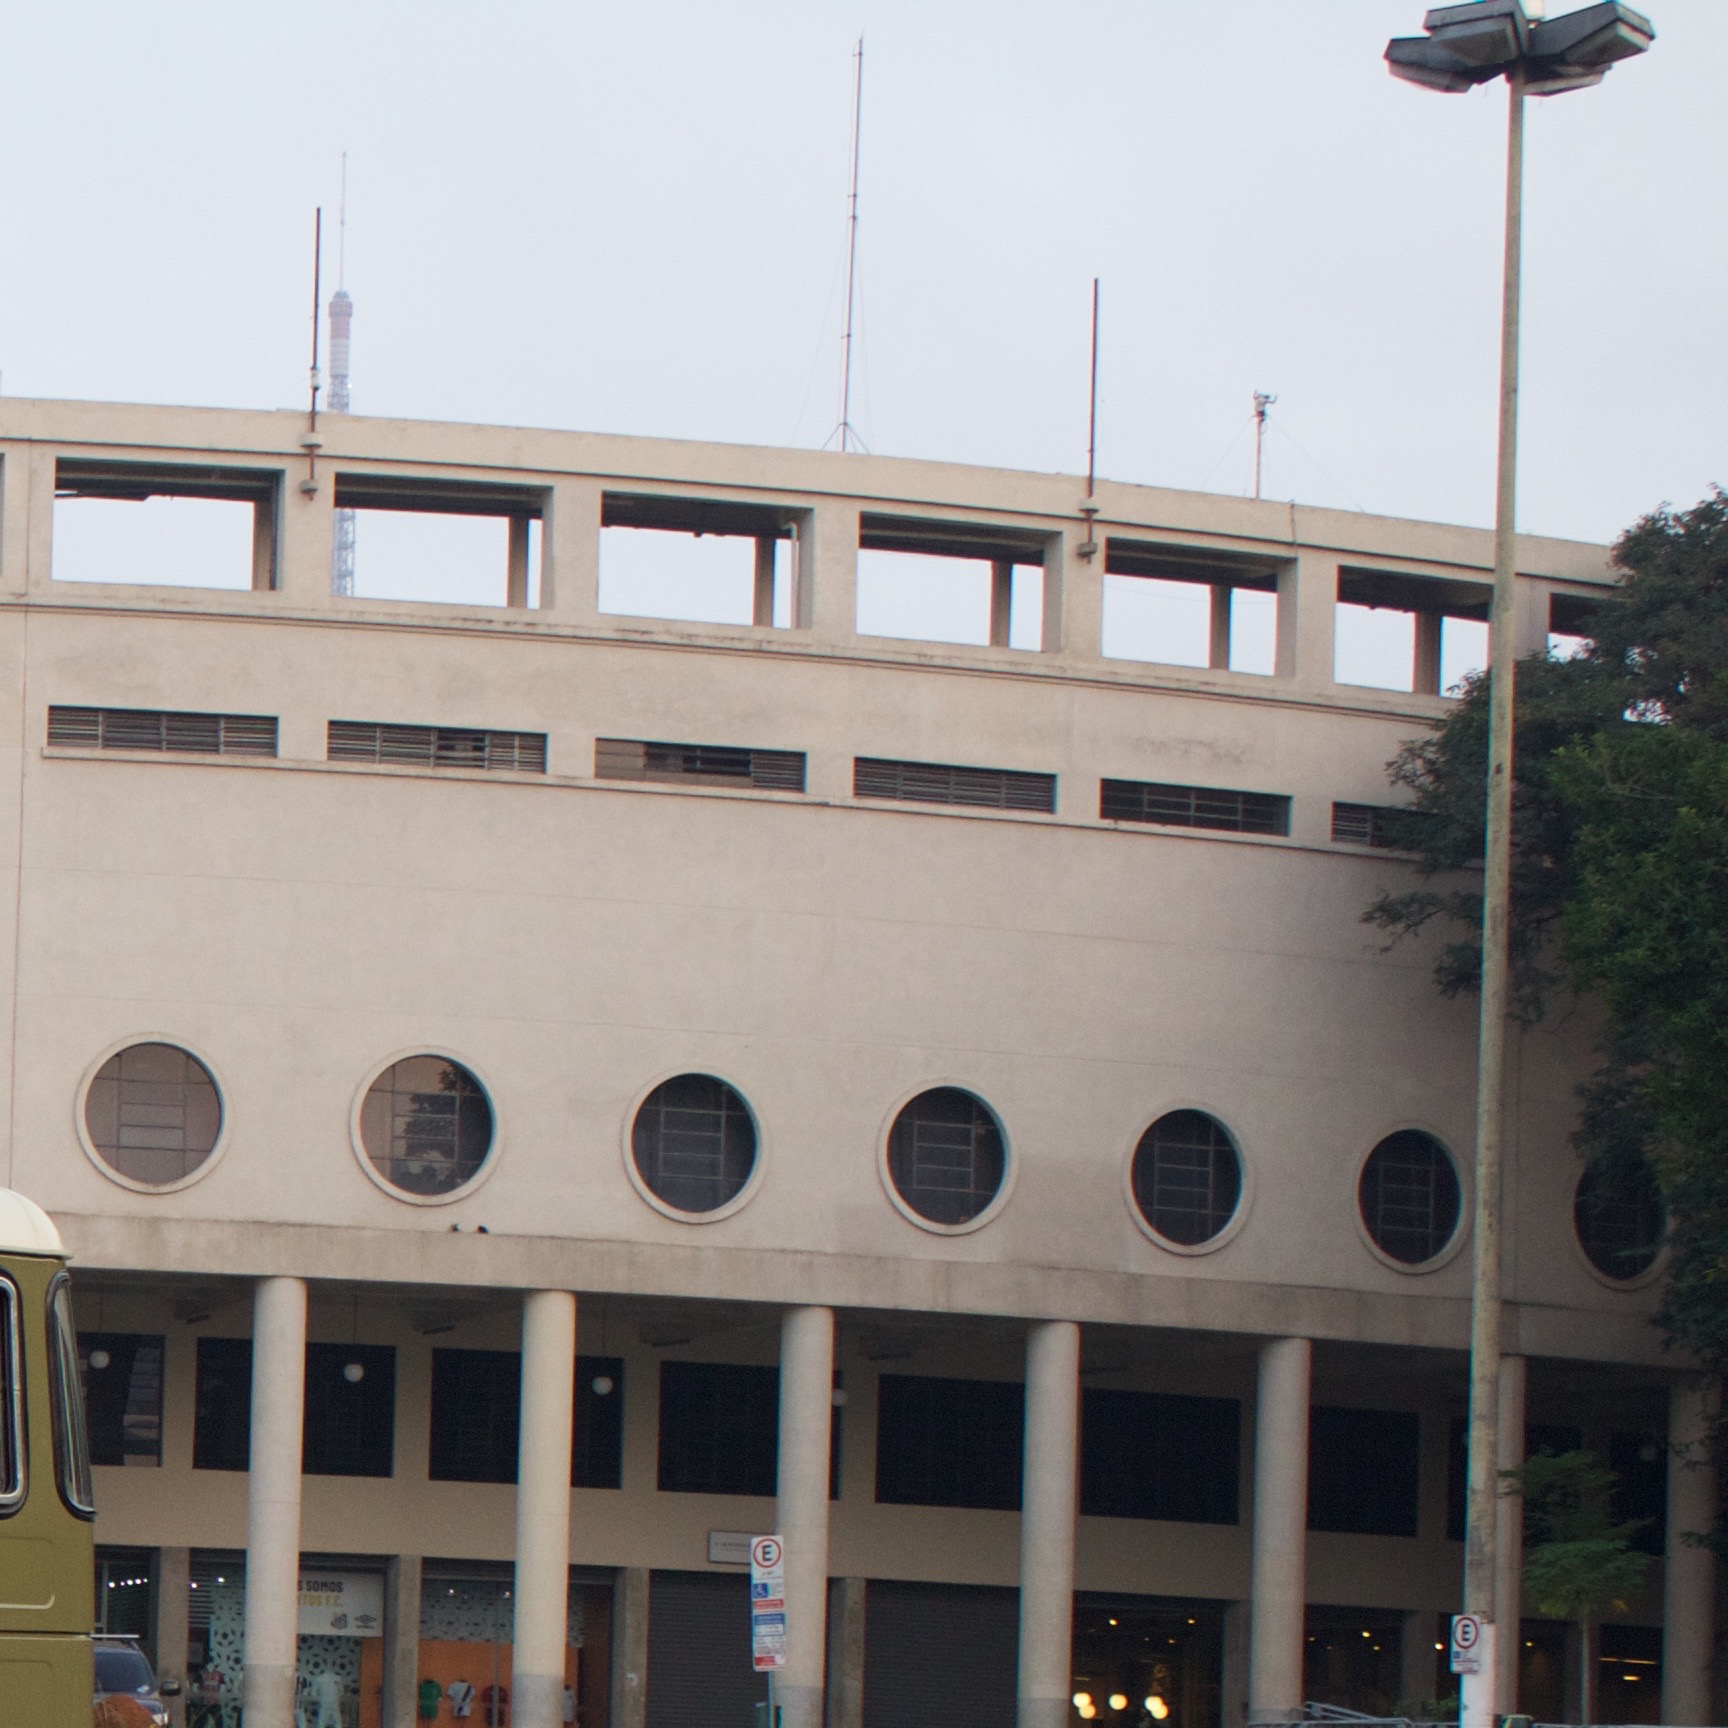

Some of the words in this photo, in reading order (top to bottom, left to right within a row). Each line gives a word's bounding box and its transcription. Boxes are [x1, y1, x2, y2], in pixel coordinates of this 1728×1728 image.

[761, 1544, 773, 1562] E
[305, 1580, 344, 1593] SOMOS
[1461, 1624, 1472, 1642] E
